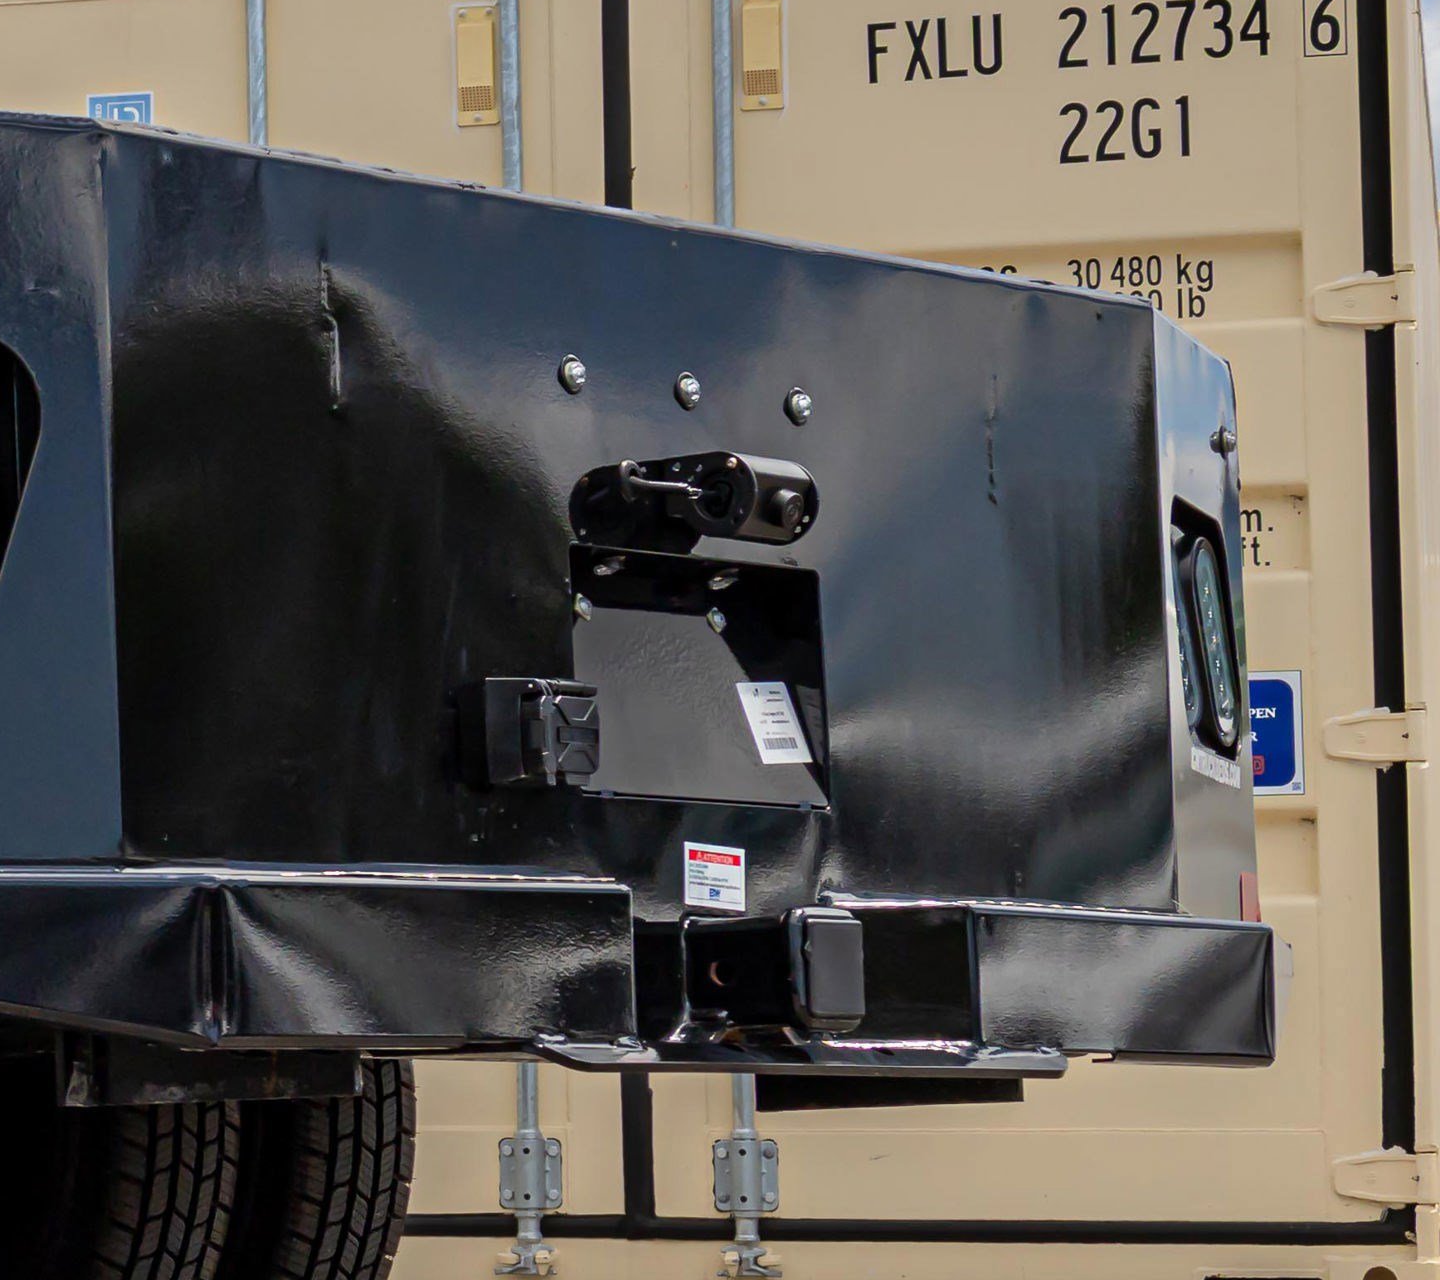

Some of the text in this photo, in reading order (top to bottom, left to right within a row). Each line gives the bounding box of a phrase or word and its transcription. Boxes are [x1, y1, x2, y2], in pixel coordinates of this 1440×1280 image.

[866, 13, 1004, 84] FXLU
[1059, 95, 1192, 164] 22G1
[1110, 255, 1162, 288] 480
[1176, 254, 1213, 292] kg
[1176, 288, 1206, 318] lb
